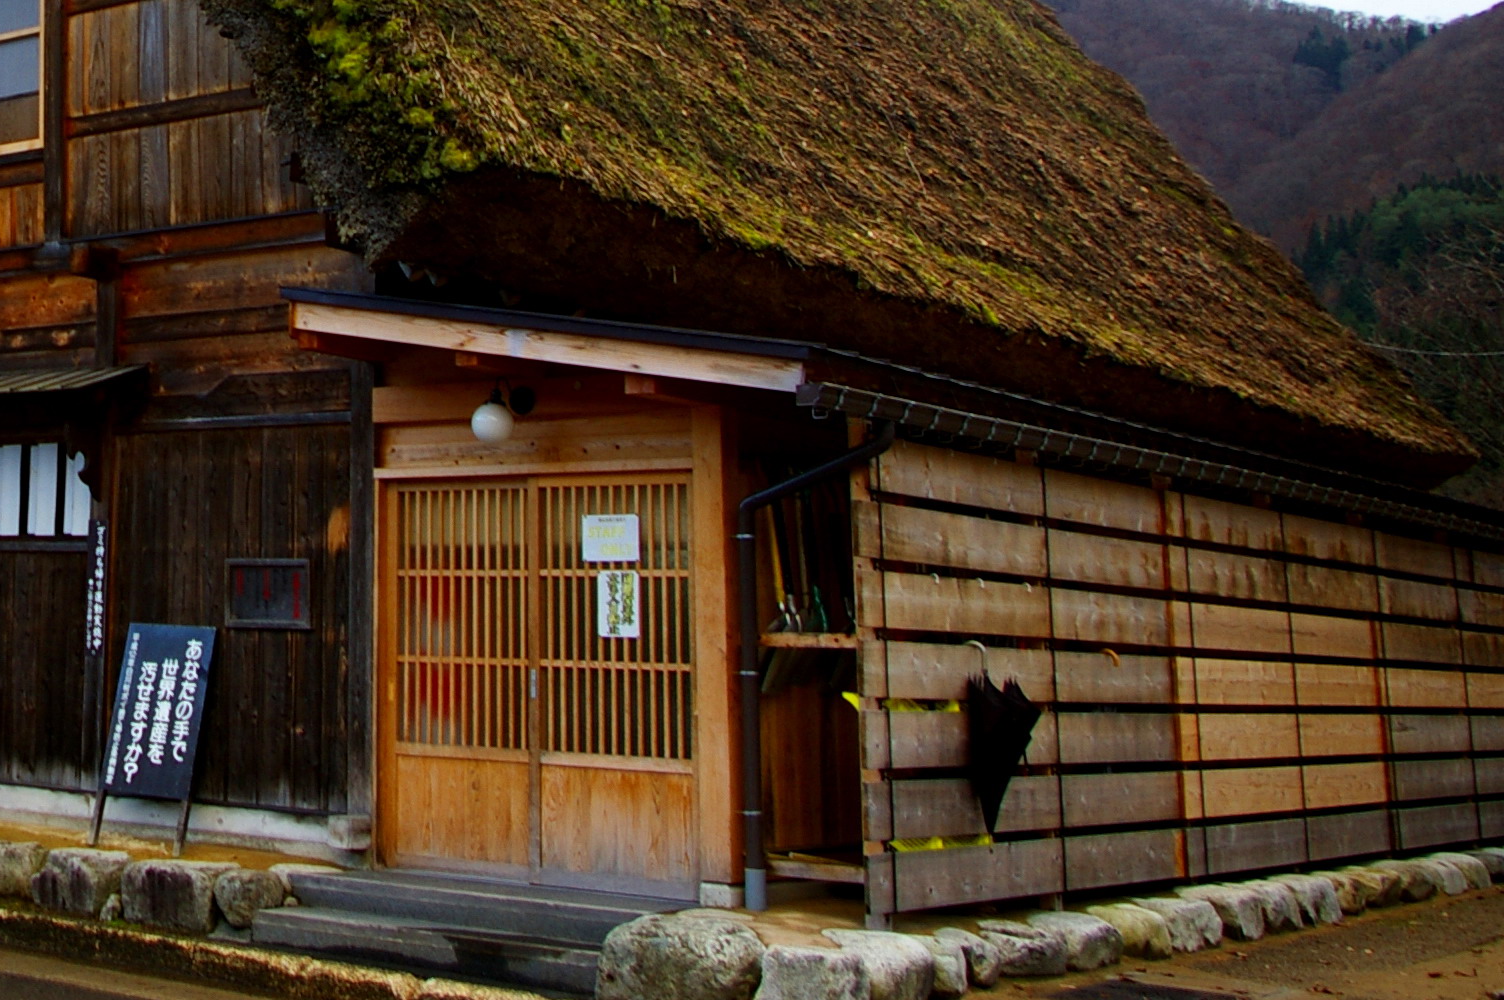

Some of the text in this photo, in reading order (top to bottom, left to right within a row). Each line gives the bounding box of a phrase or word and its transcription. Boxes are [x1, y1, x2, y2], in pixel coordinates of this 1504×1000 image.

[146, 657, 180, 766] 世界遺産を
[170, 638, 203, 763] あなたの手で
